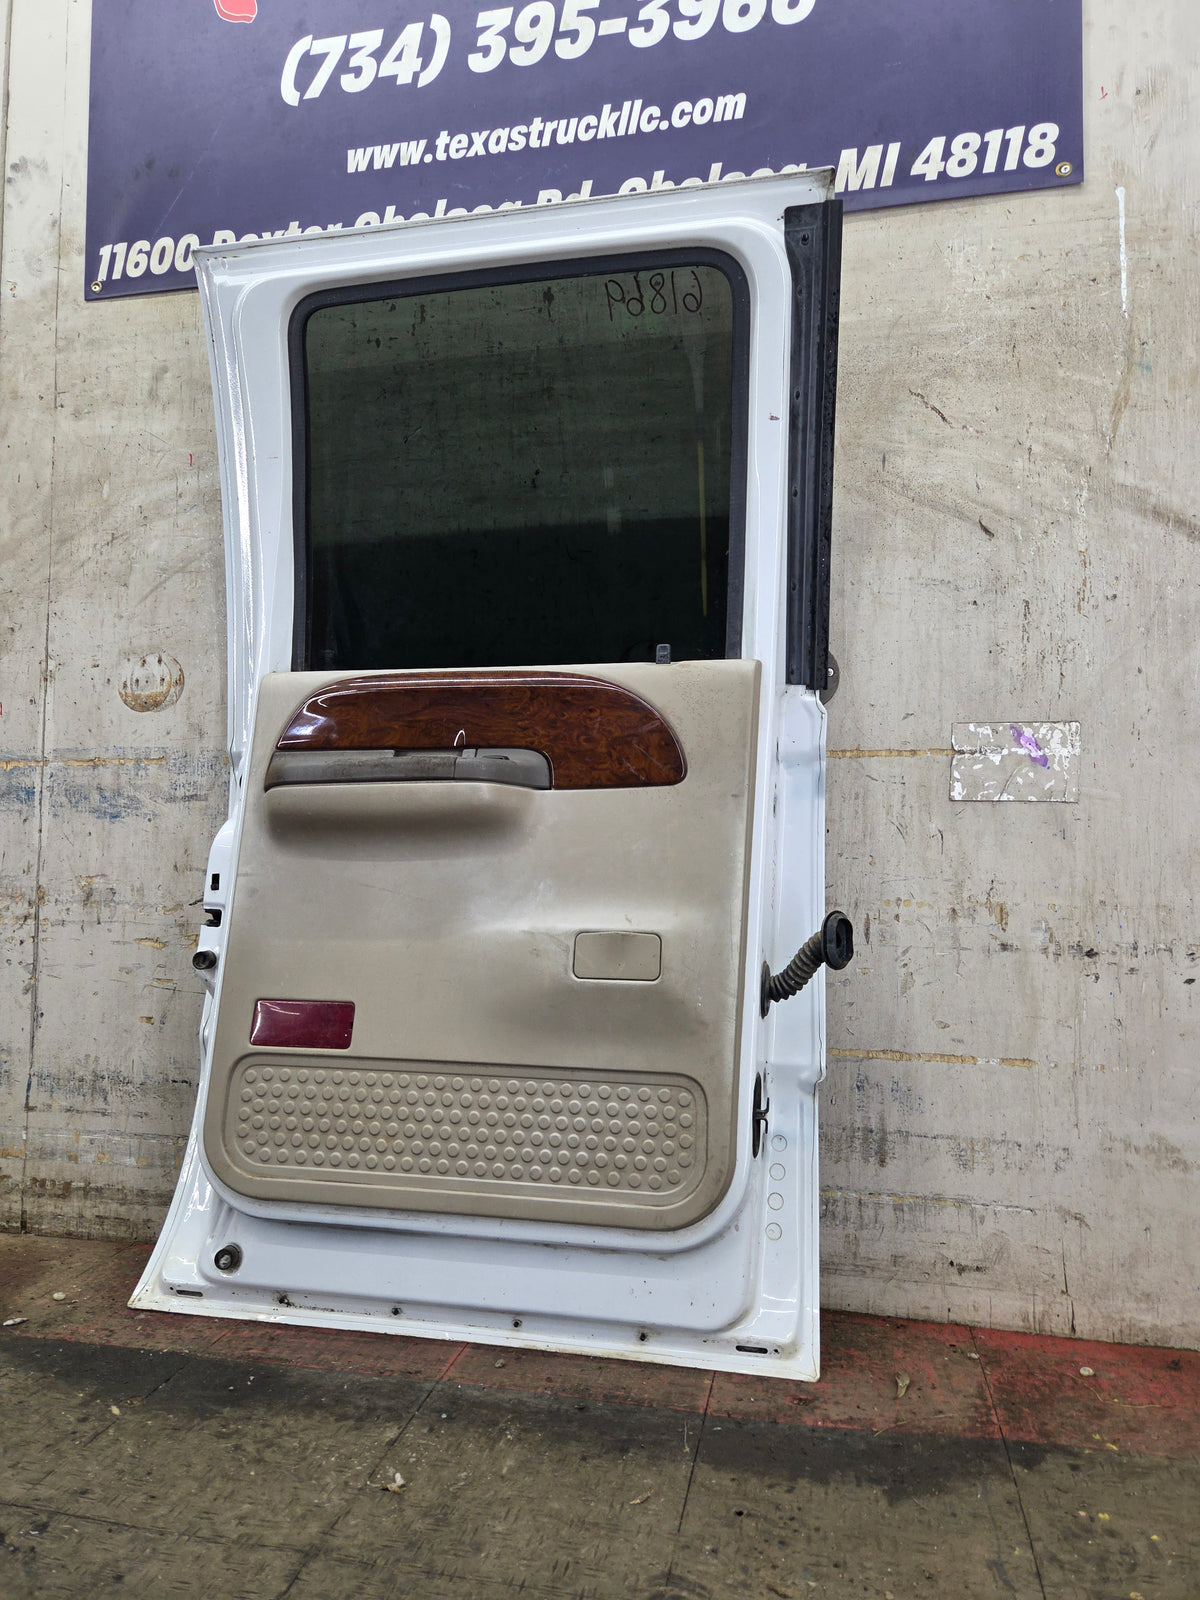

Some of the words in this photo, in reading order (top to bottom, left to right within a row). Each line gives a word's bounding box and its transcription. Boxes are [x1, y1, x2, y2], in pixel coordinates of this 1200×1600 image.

[281, 13, 451, 107] (734)
[346, 92, 747, 173] www.texastruckllc.com
[97, 233, 200, 281] 11600
[835, 141, 901, 193] MI
[910, 122, 1060, 181] 48118
